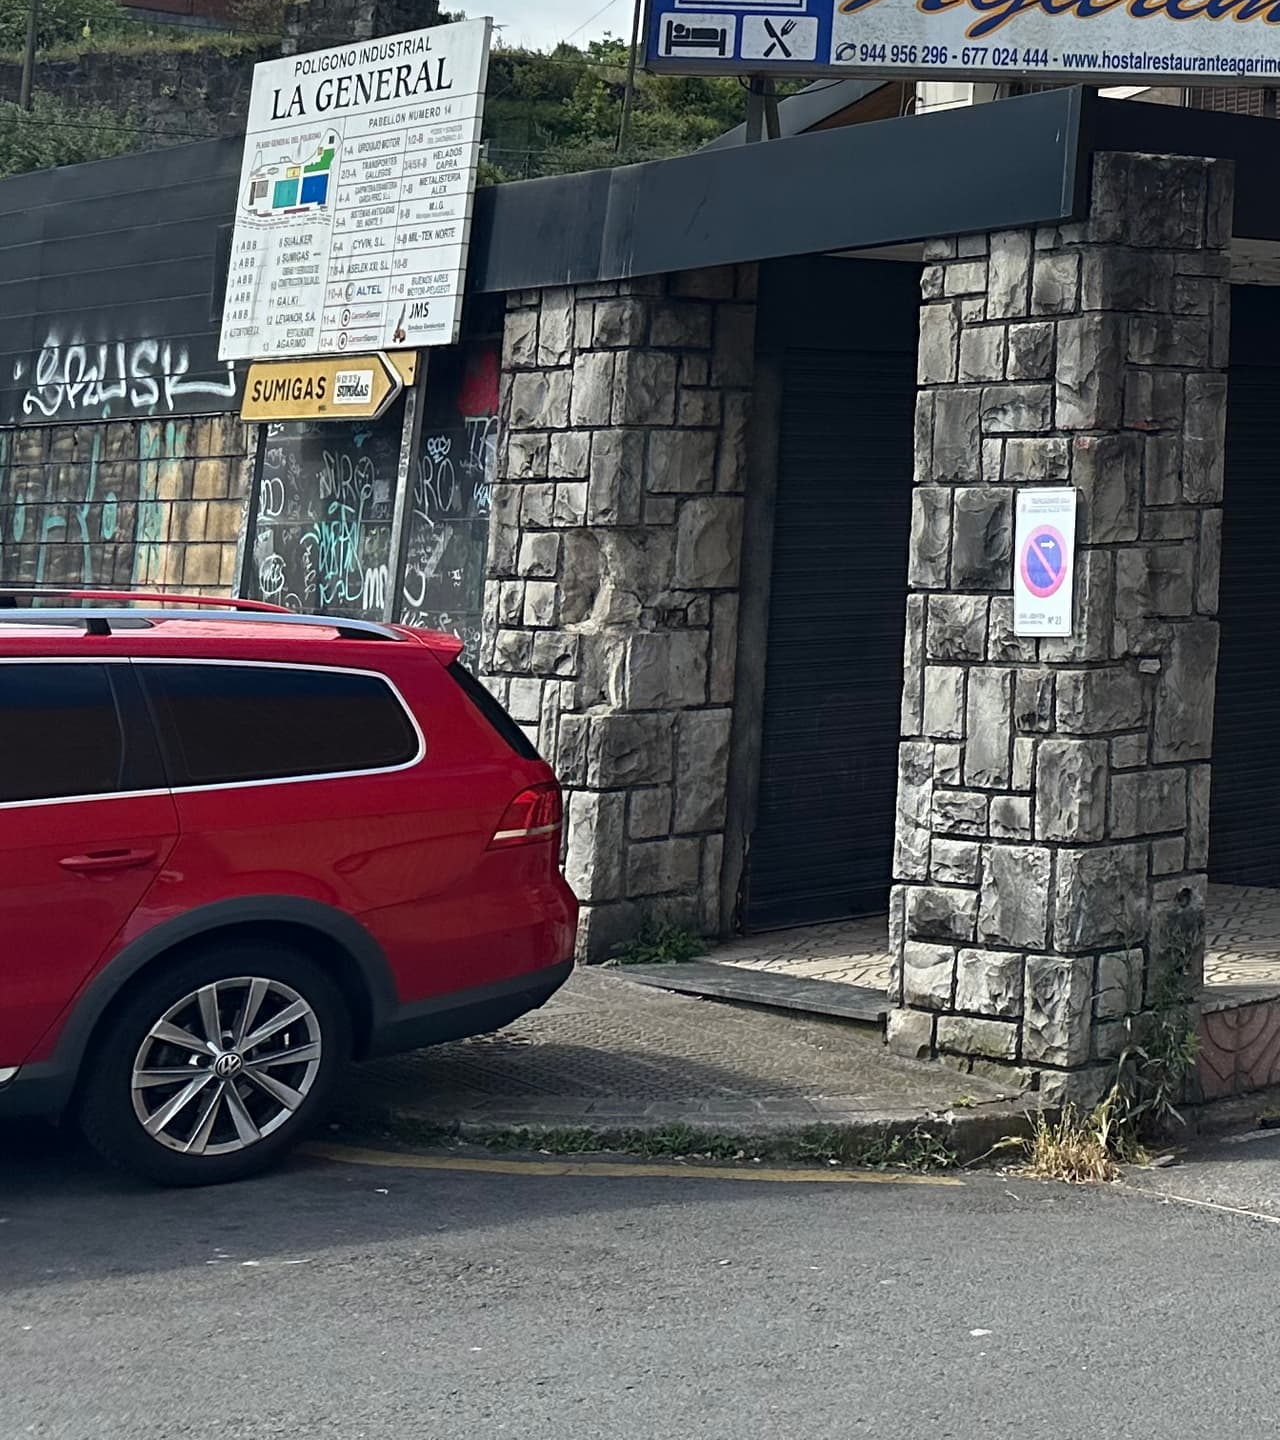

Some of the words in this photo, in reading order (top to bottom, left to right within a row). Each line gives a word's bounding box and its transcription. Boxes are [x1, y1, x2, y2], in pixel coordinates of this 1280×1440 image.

[295, 50, 356, 77] POLIGONO
[359, 36, 432, 64] INDUSTRIAL
[860, 43, 887, 63] 944
[891, 44, 917, 63] 956
[921, 46, 948, 64] 296
[961, 47, 988, 66] 677
[992, 48, 1019, 66] 024
[1021, 49, 1049, 67] 444
[271, 83, 306, 121] LA
[315, 57, 453, 111] GENERAL
[368, 113, 406, 128] PABELLON
[409, 106, 441, 121] NUMERO
[433, 146, 463, 160] HELADOS
[434, 227, 456, 239] NORTE
[241, 240, 257, 250] ABB
[239, 257, 255, 268] ABB
[237, 274, 253, 284] ABB
[235, 291, 251, 302] ABB
[356, 285, 382, 297] ALTEL
[232, 309, 248, 320] ABB
[409, 302, 430, 319] JMS
[276, 338, 306, 349] AGARIMO
[251, 376, 327, 403] SUMIGAS
